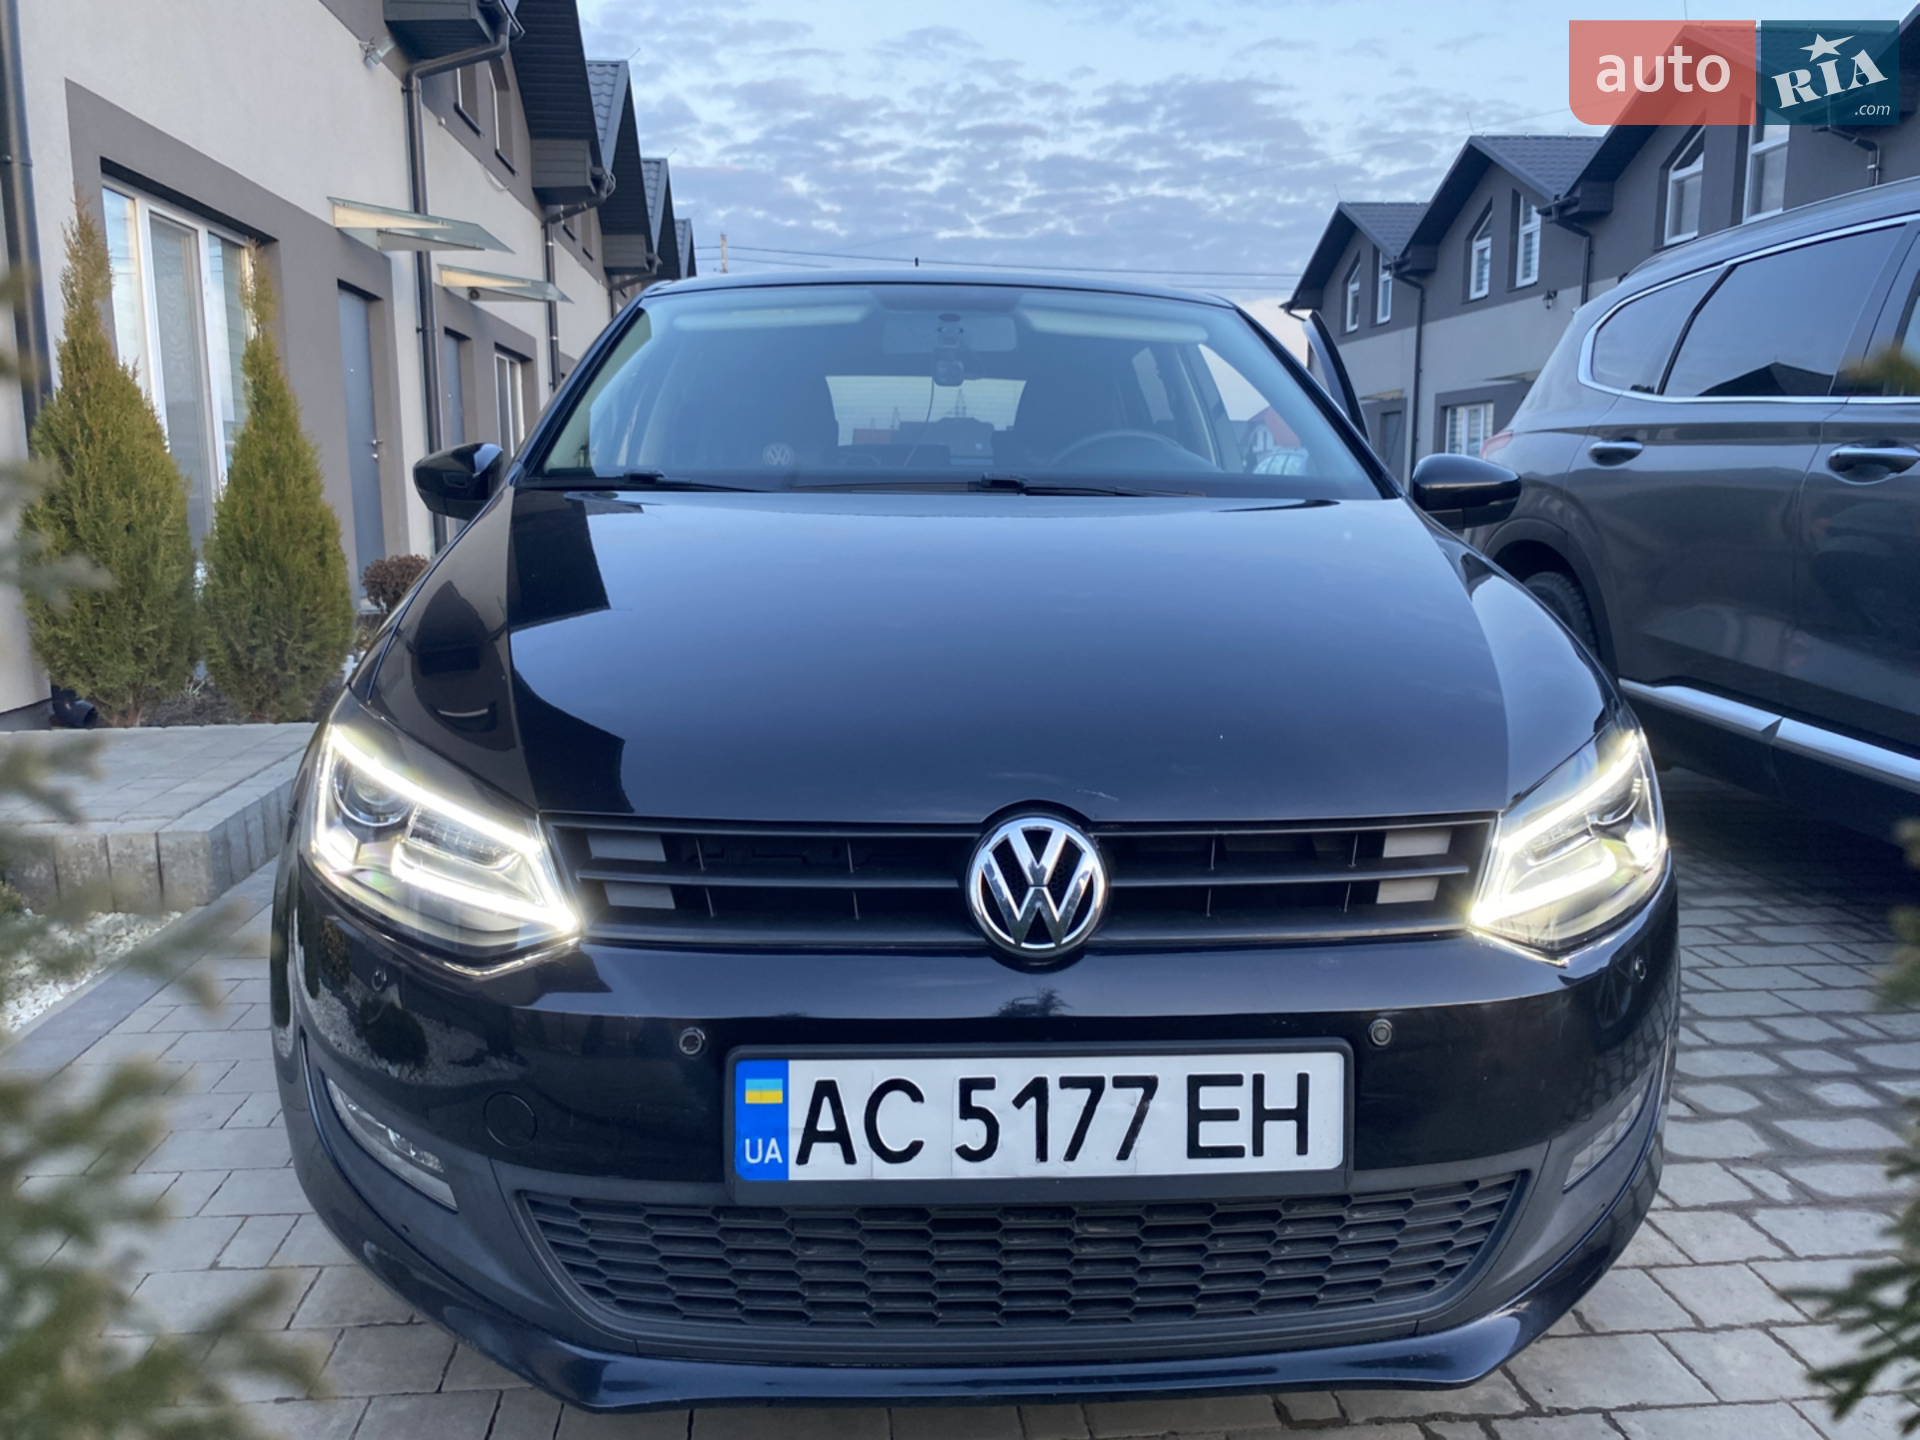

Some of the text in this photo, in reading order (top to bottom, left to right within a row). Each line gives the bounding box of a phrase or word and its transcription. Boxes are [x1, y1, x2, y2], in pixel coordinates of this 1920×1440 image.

[971, 818, 1104, 952] VW
[744, 1138, 783, 1164] UA
[795, 1072, 1311, 1166] AC 5177 EH
